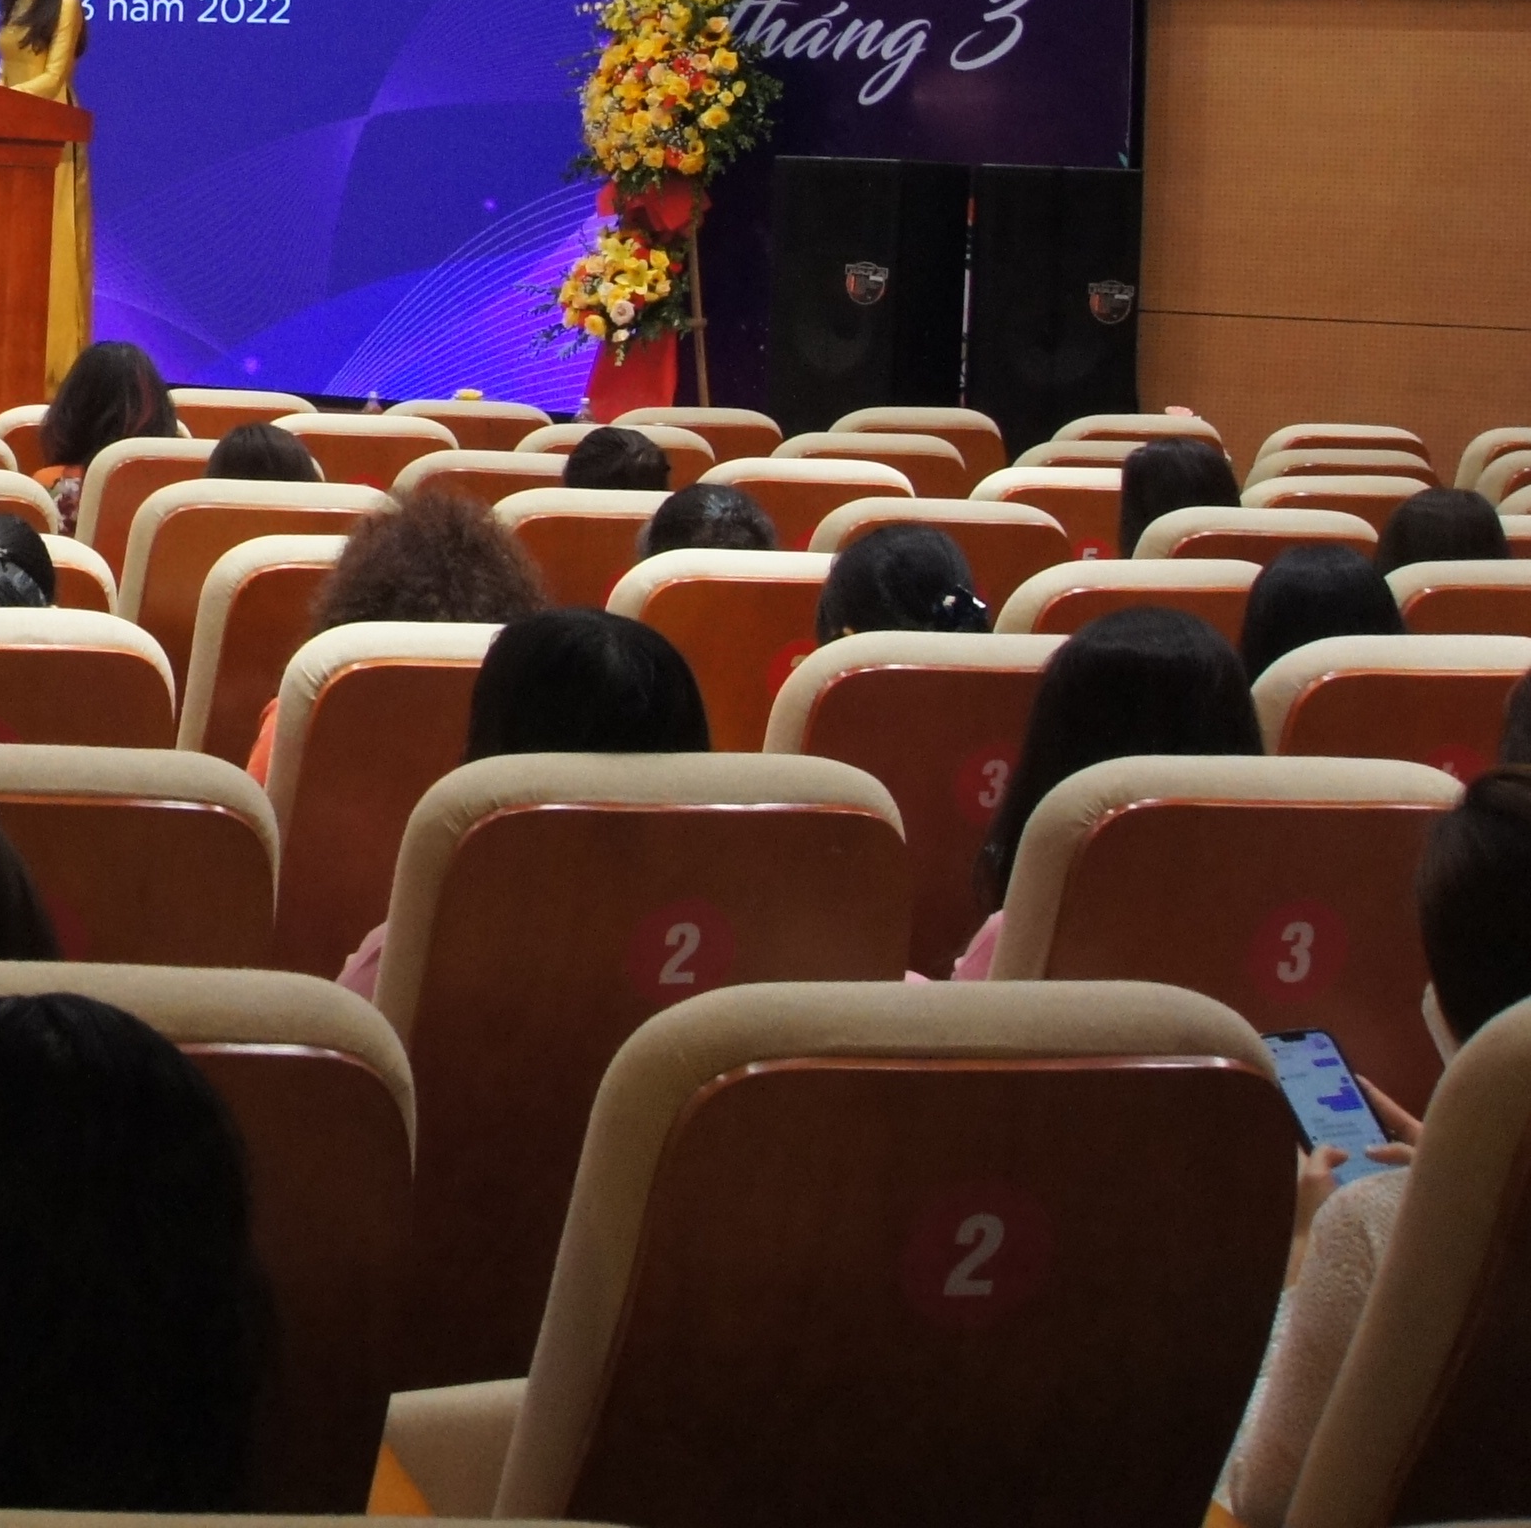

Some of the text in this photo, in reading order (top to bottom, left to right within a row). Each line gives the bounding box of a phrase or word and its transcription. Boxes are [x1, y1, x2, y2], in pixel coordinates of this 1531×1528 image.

[978, 759, 1009, 808] 3
[658, 921, 702, 985] 2
[1277, 921, 1316, 984] 3
[943, 1212, 1007, 1296] 2
